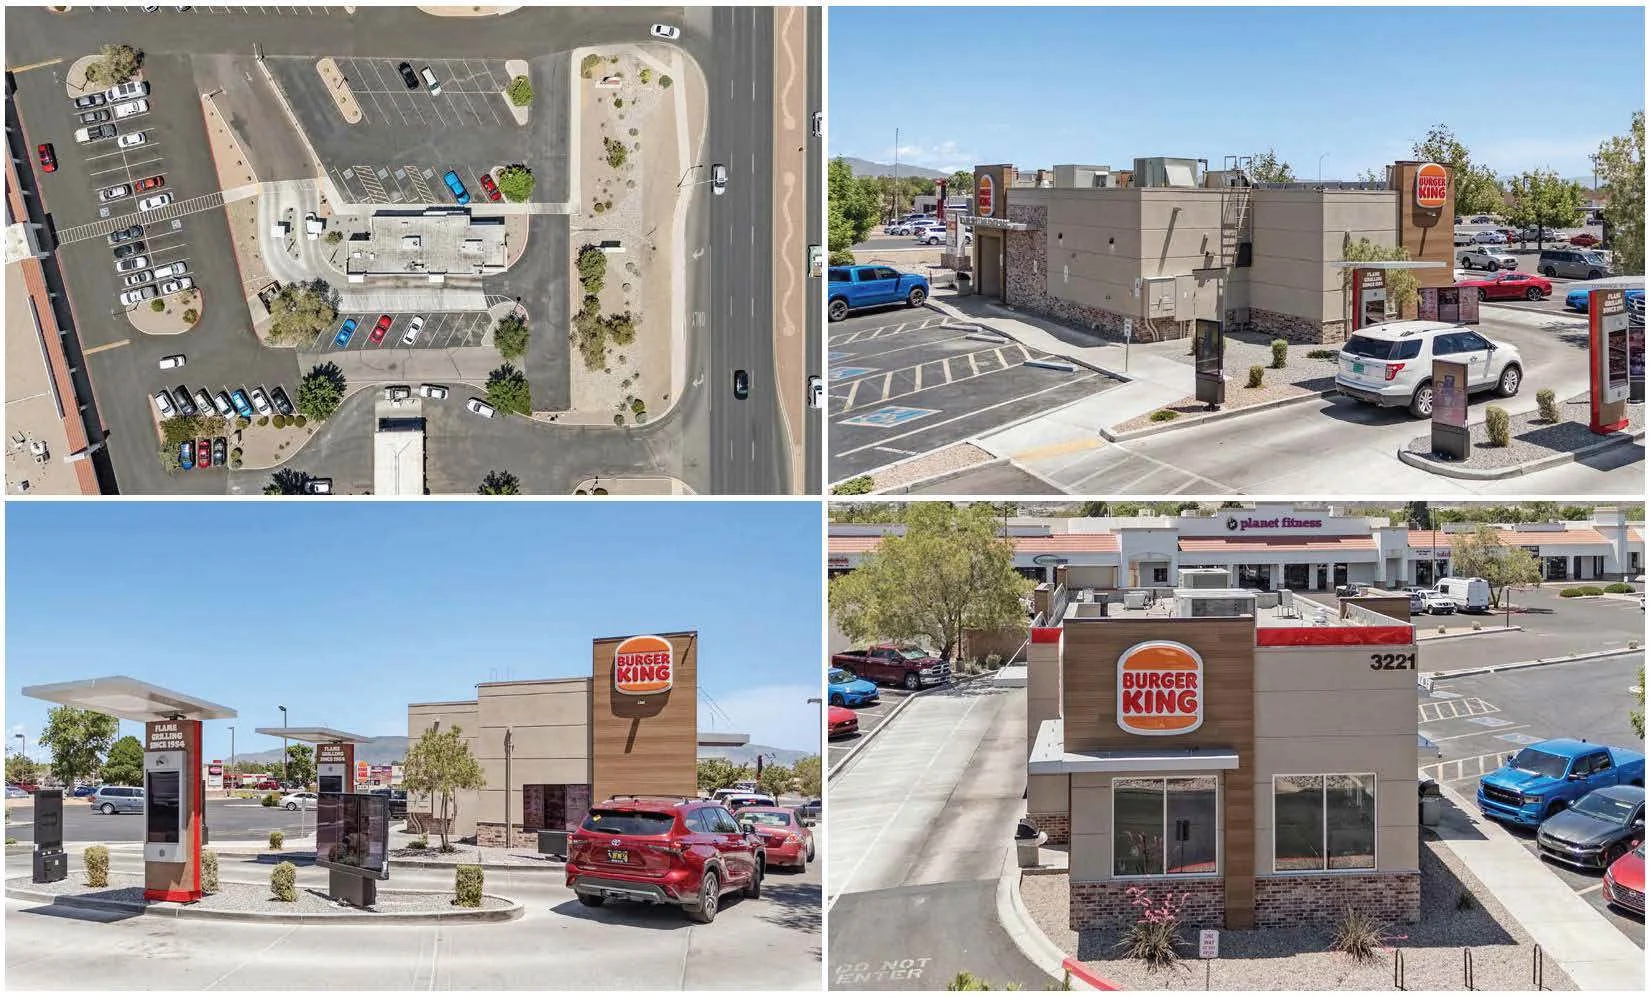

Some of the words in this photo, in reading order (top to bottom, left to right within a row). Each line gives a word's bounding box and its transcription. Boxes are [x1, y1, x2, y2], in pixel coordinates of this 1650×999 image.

[1419, 177, 1446, 187] BURGER
[1419, 187, 1446, 199] KING
[1240, 517, 1279, 531] planet
[1281, 517, 1322, 528] fitness
[617, 653, 670, 666] BURGER
[1370, 653, 1416, 671] 3221
[617, 665, 671, 683] KING
[1122, 672, 1198, 689] BURGER
[1122, 690, 1198, 714] KING
[155, 724, 178, 732] FLAME
[152, 732, 183, 741] GRILLING
[881, 957, 933, 971] NOT
[835, 968, 924, 985] ENTER
